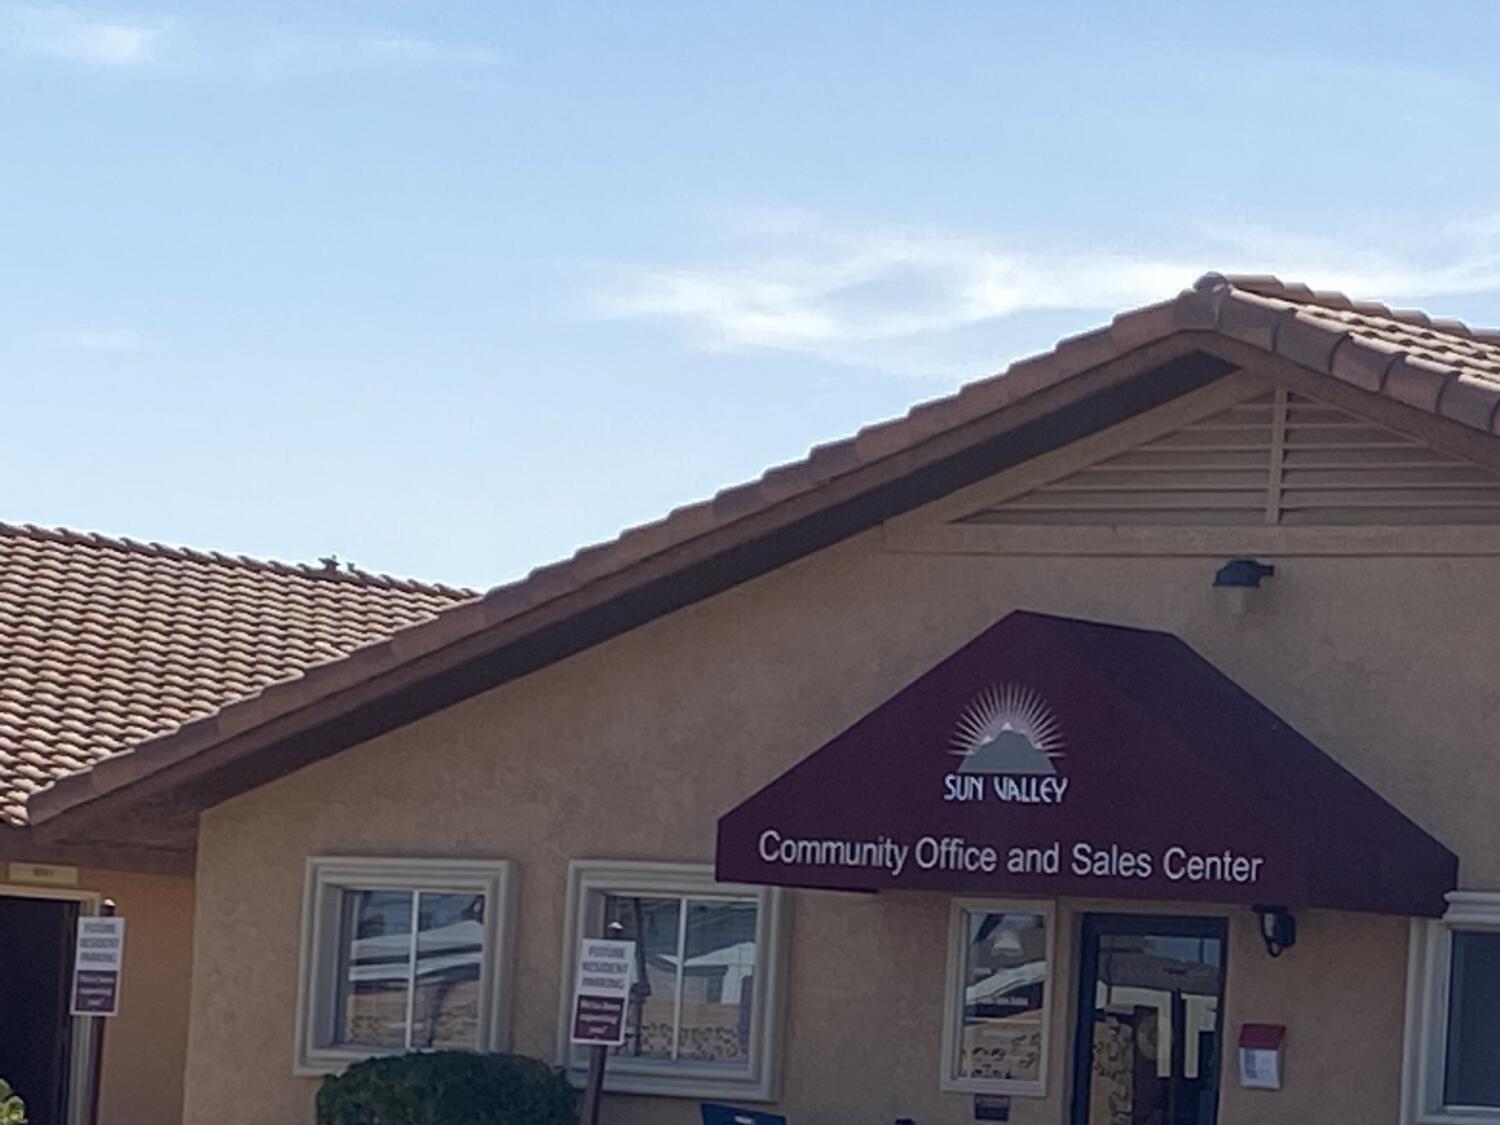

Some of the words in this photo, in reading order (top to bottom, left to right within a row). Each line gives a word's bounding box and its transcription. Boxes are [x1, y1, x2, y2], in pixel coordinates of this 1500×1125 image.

[943, 773, 984, 801] SUN
[993, 775, 1070, 803] VALLEY
[758, 830, 908, 876] Community
[915, 836, 998, 872] Office
[1007, 843, 1060, 875] and
[1071, 843, 1153, 879] Sales
[1163, 847, 1264, 883] Center
